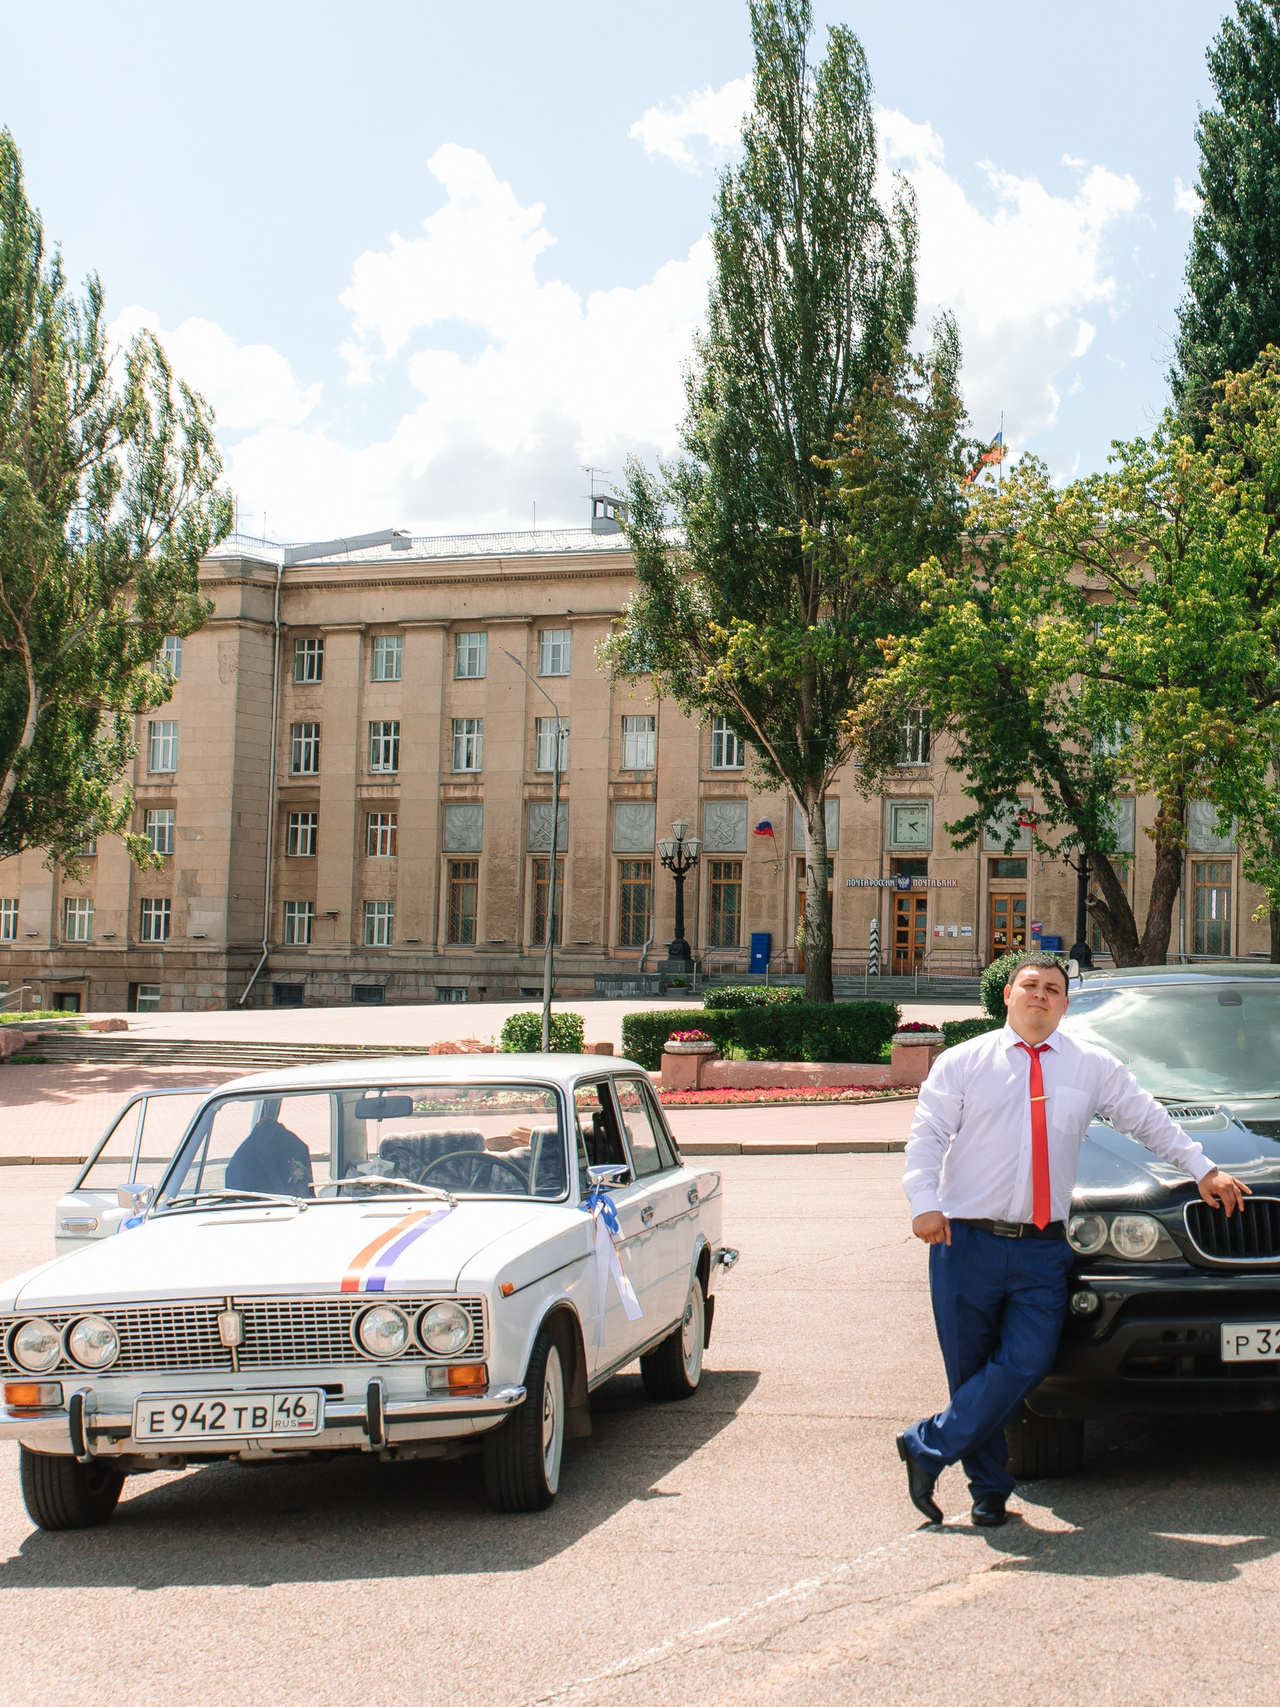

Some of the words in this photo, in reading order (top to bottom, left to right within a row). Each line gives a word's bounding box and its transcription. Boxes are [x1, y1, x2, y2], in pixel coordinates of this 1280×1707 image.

[845, 878, 869, 888] ПОЧТА
[869, 878, 896, 888] РОССИИ
[912, 878, 936, 888] ПОЧТА
[936, 878, 959, 888] БАНК
[277, 1396, 308, 1419] 46
[274, 1419, 298, 1429] RUS
